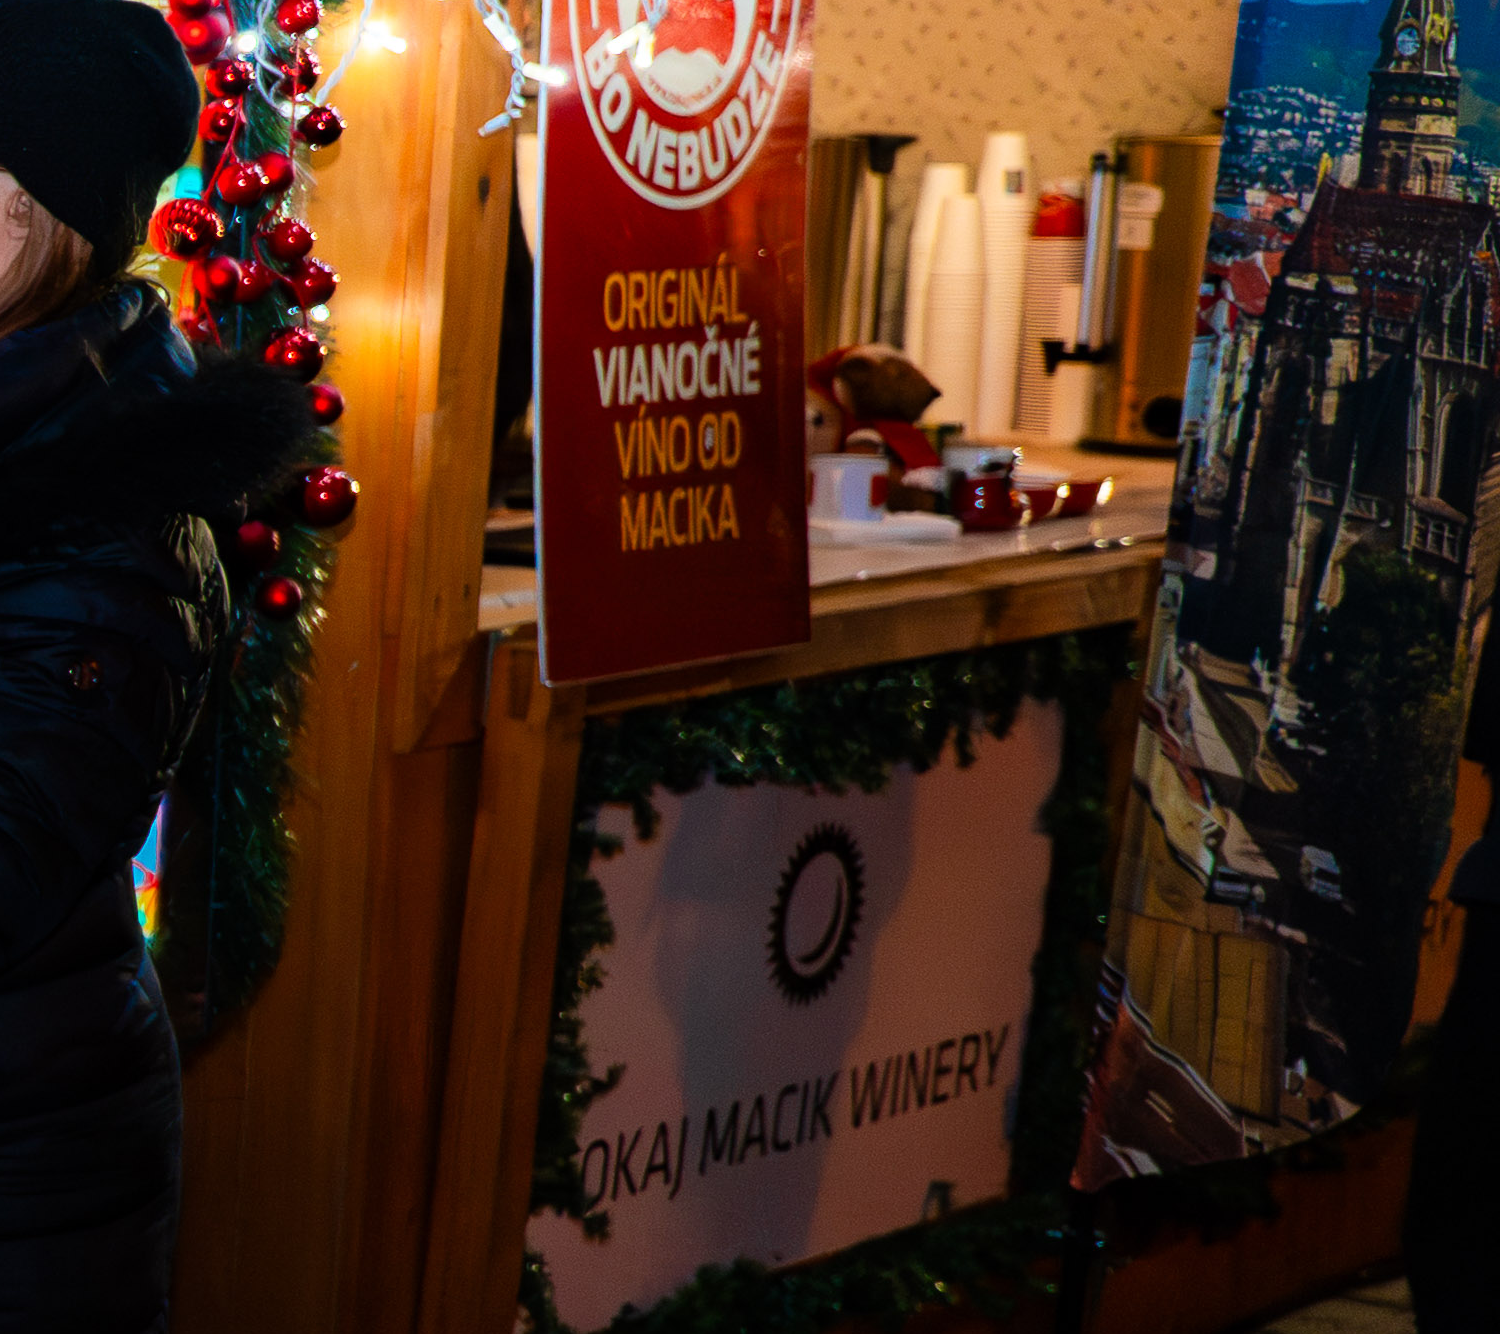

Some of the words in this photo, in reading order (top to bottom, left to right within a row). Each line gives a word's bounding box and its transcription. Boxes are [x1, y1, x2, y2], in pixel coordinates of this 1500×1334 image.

[584, 27, 634, 134] BO
[625, 29, 783, 191] NEBUDZE
[603, 251, 749, 333] ORIGINÁL
[592, 320, 761, 408] VIANOČNÉ
[614, 403, 691, 481] VÍNO
[697, 410, 742, 470] OD
[619, 483, 740, 553] MACIKA
[578, 1119, 690, 1210] OKAJ
[700, 1070, 842, 1177] MACIK
[849, 1025, 1009, 1130] WINERY
